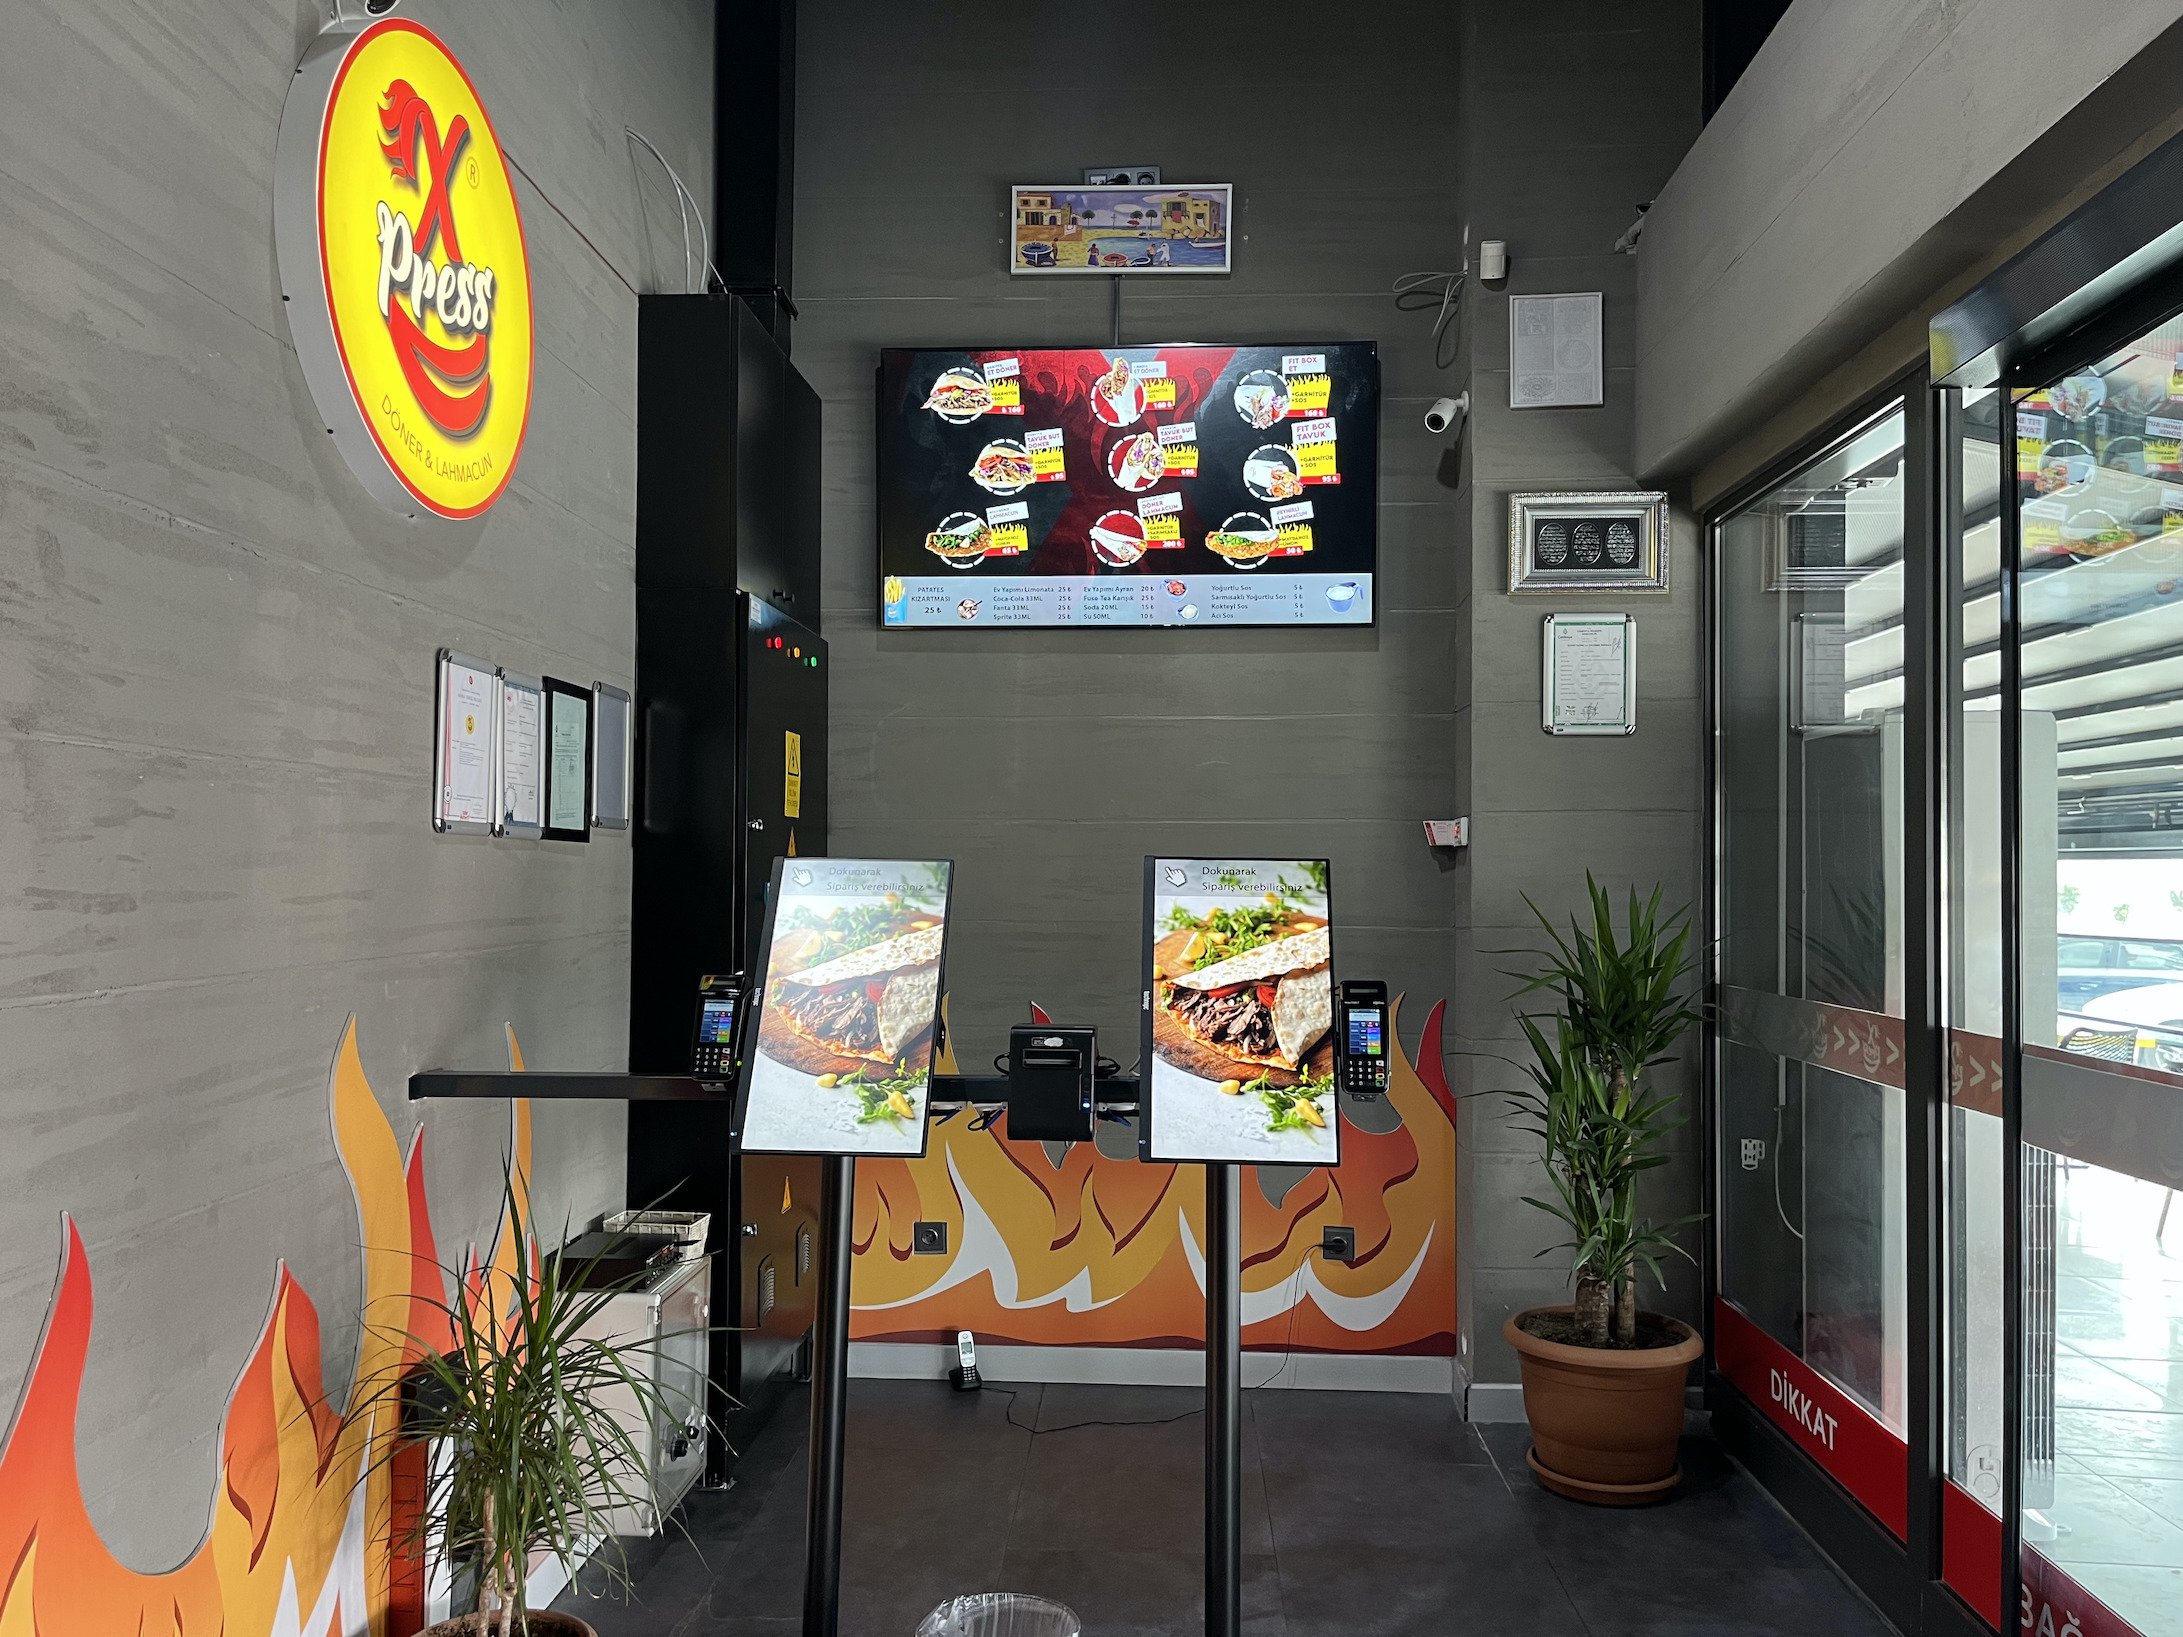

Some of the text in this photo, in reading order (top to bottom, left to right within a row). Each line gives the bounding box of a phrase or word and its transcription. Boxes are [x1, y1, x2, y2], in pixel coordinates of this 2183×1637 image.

[1288, 356, 1317, 365] FIT BOX
[996, 365, 1017, 374] DÖNER
[1296, 422, 1331, 432] FIT BOX
[381, 393, 493, 484] DÖNER & LAHMACUN
[1027, 435, 1047, 443] TAVUK
[1297, 431, 1326, 440] TAVUK
[1142, 504, 1179, 515] LAHMACUN
[924, 606, 935, 614] 25
[828, 867, 882, 876] Dokunarak
[1202, 866, 1257, 876] Dokunarak
[827, 882, 924, 892] Sipariş verebilirsiniz
[1202, 882, 1303, 892] Sipariş verebilirsiniz
[1771, 1367, 1838, 1451] DİKKAT
